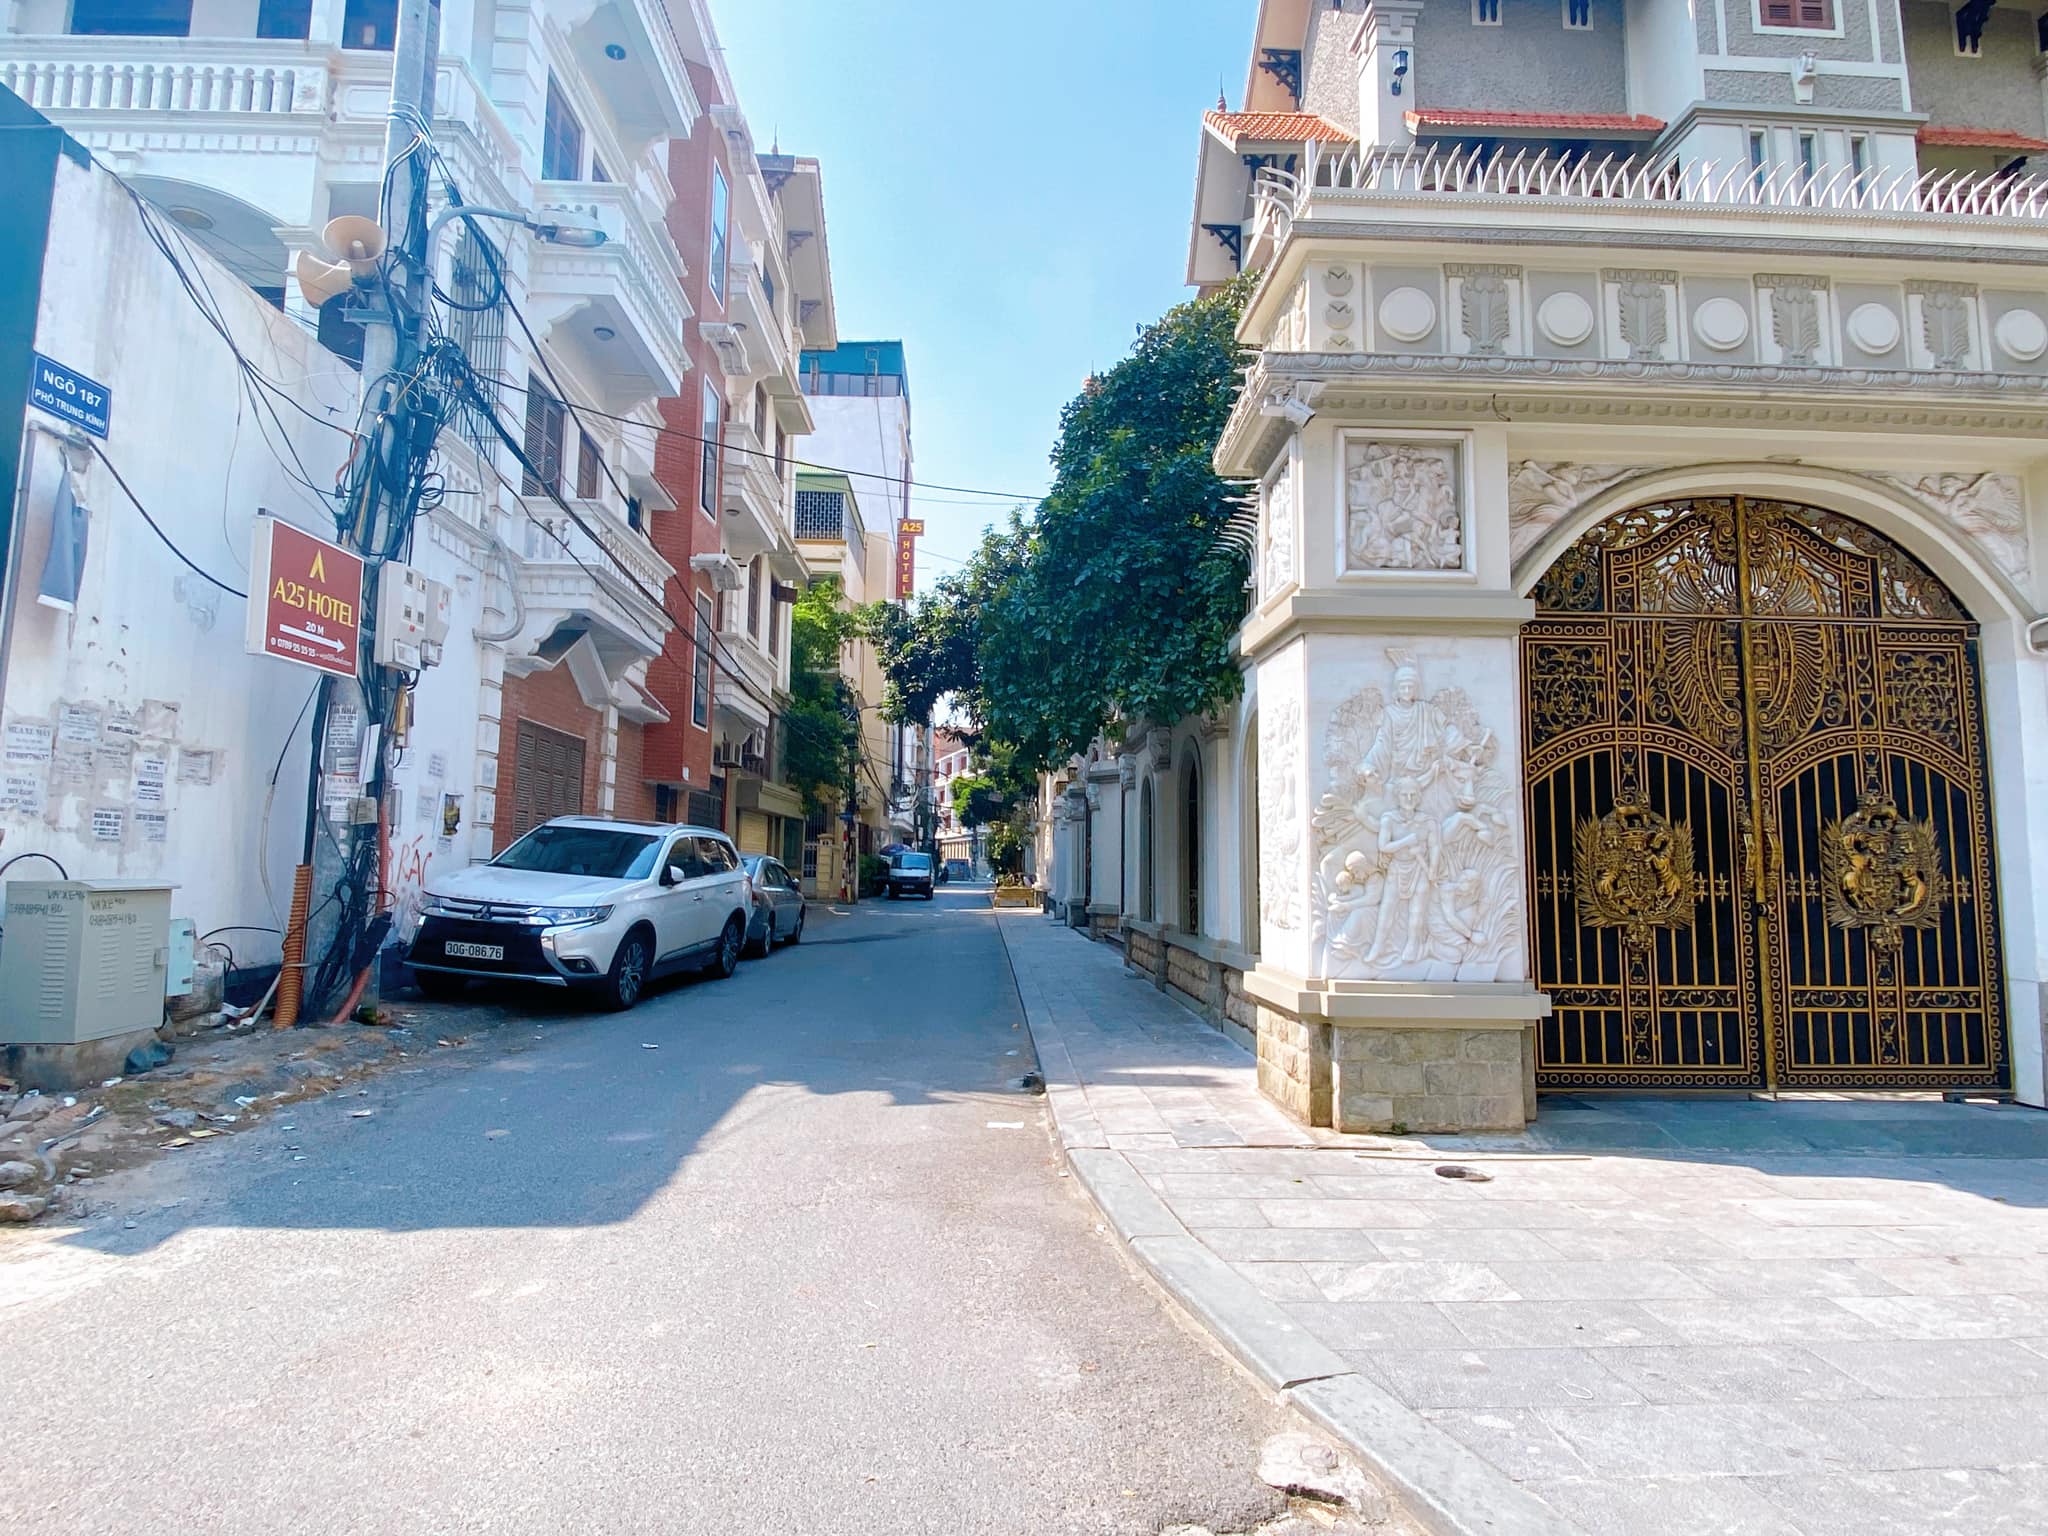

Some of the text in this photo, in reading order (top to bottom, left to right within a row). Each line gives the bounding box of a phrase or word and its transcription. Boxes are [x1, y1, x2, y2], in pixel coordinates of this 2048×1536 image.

[43, 369, 102, 407] NGÕ 187
[56, 398, 84, 419] TRUNG
[86, 411, 105, 429] KÍNH
[902, 523, 922, 532] A25
[902, 541, 910, 594] HOTEL
[273, 577, 354, 628] A25 HOTEL
[305, 621, 324, 636] 20 M
